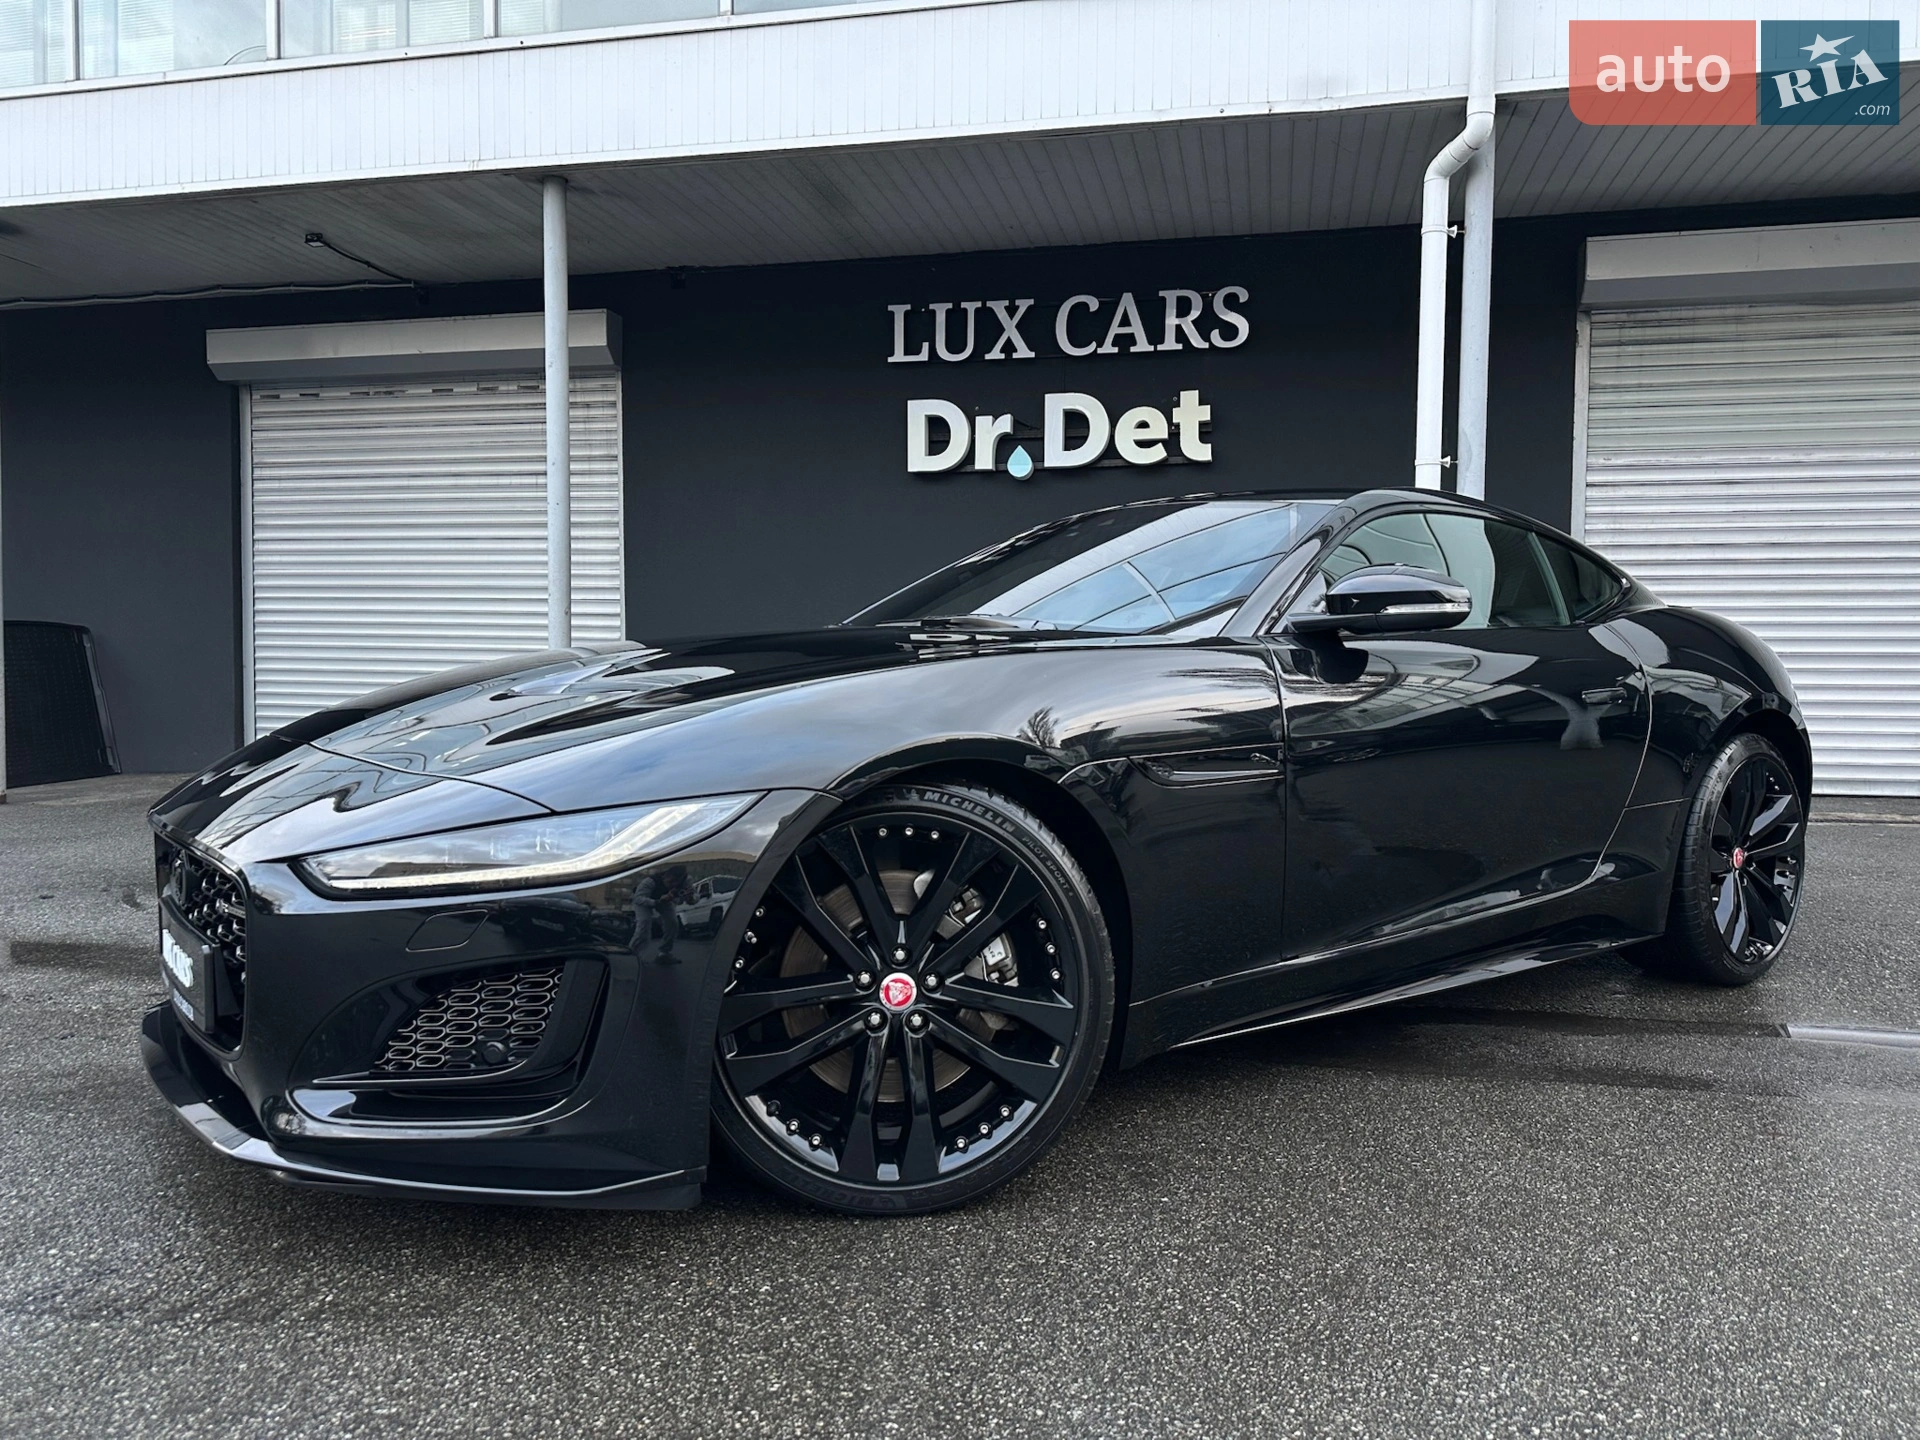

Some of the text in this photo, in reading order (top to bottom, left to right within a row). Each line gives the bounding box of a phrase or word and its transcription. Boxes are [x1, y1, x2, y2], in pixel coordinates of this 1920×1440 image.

[887, 285, 1250, 363] LUX CARS
[923, 791, 1070, 889] MICHELIN PILOT SPORT
